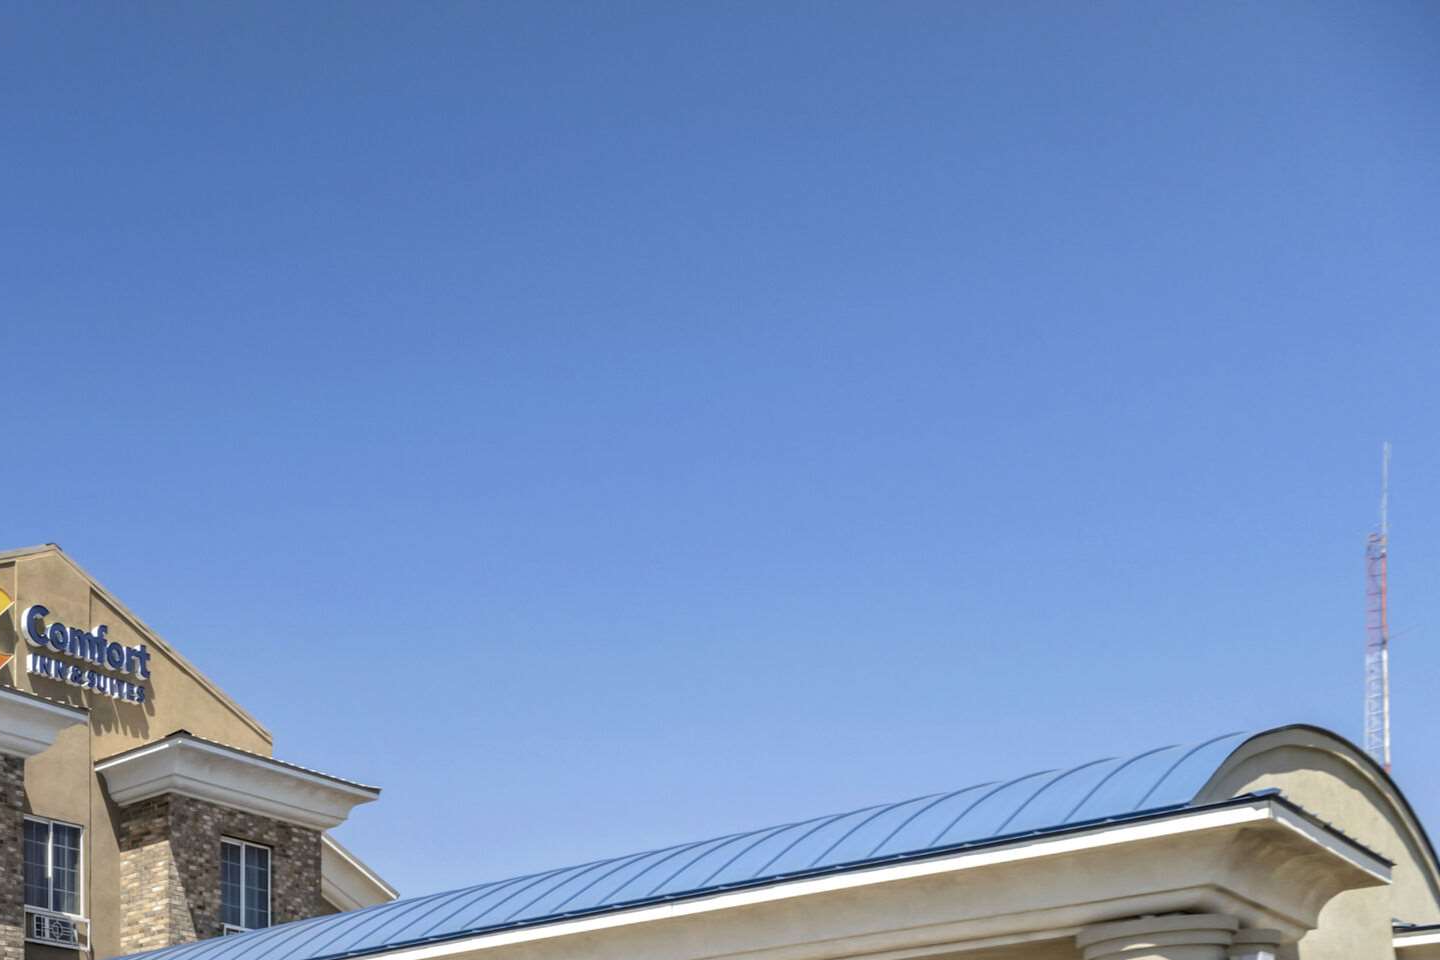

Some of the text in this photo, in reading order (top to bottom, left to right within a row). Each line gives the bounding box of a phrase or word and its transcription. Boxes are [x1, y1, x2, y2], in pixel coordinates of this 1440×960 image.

[21, 604, 151, 680] Comfort
[26, 653, 146, 705] INN & SUITES
